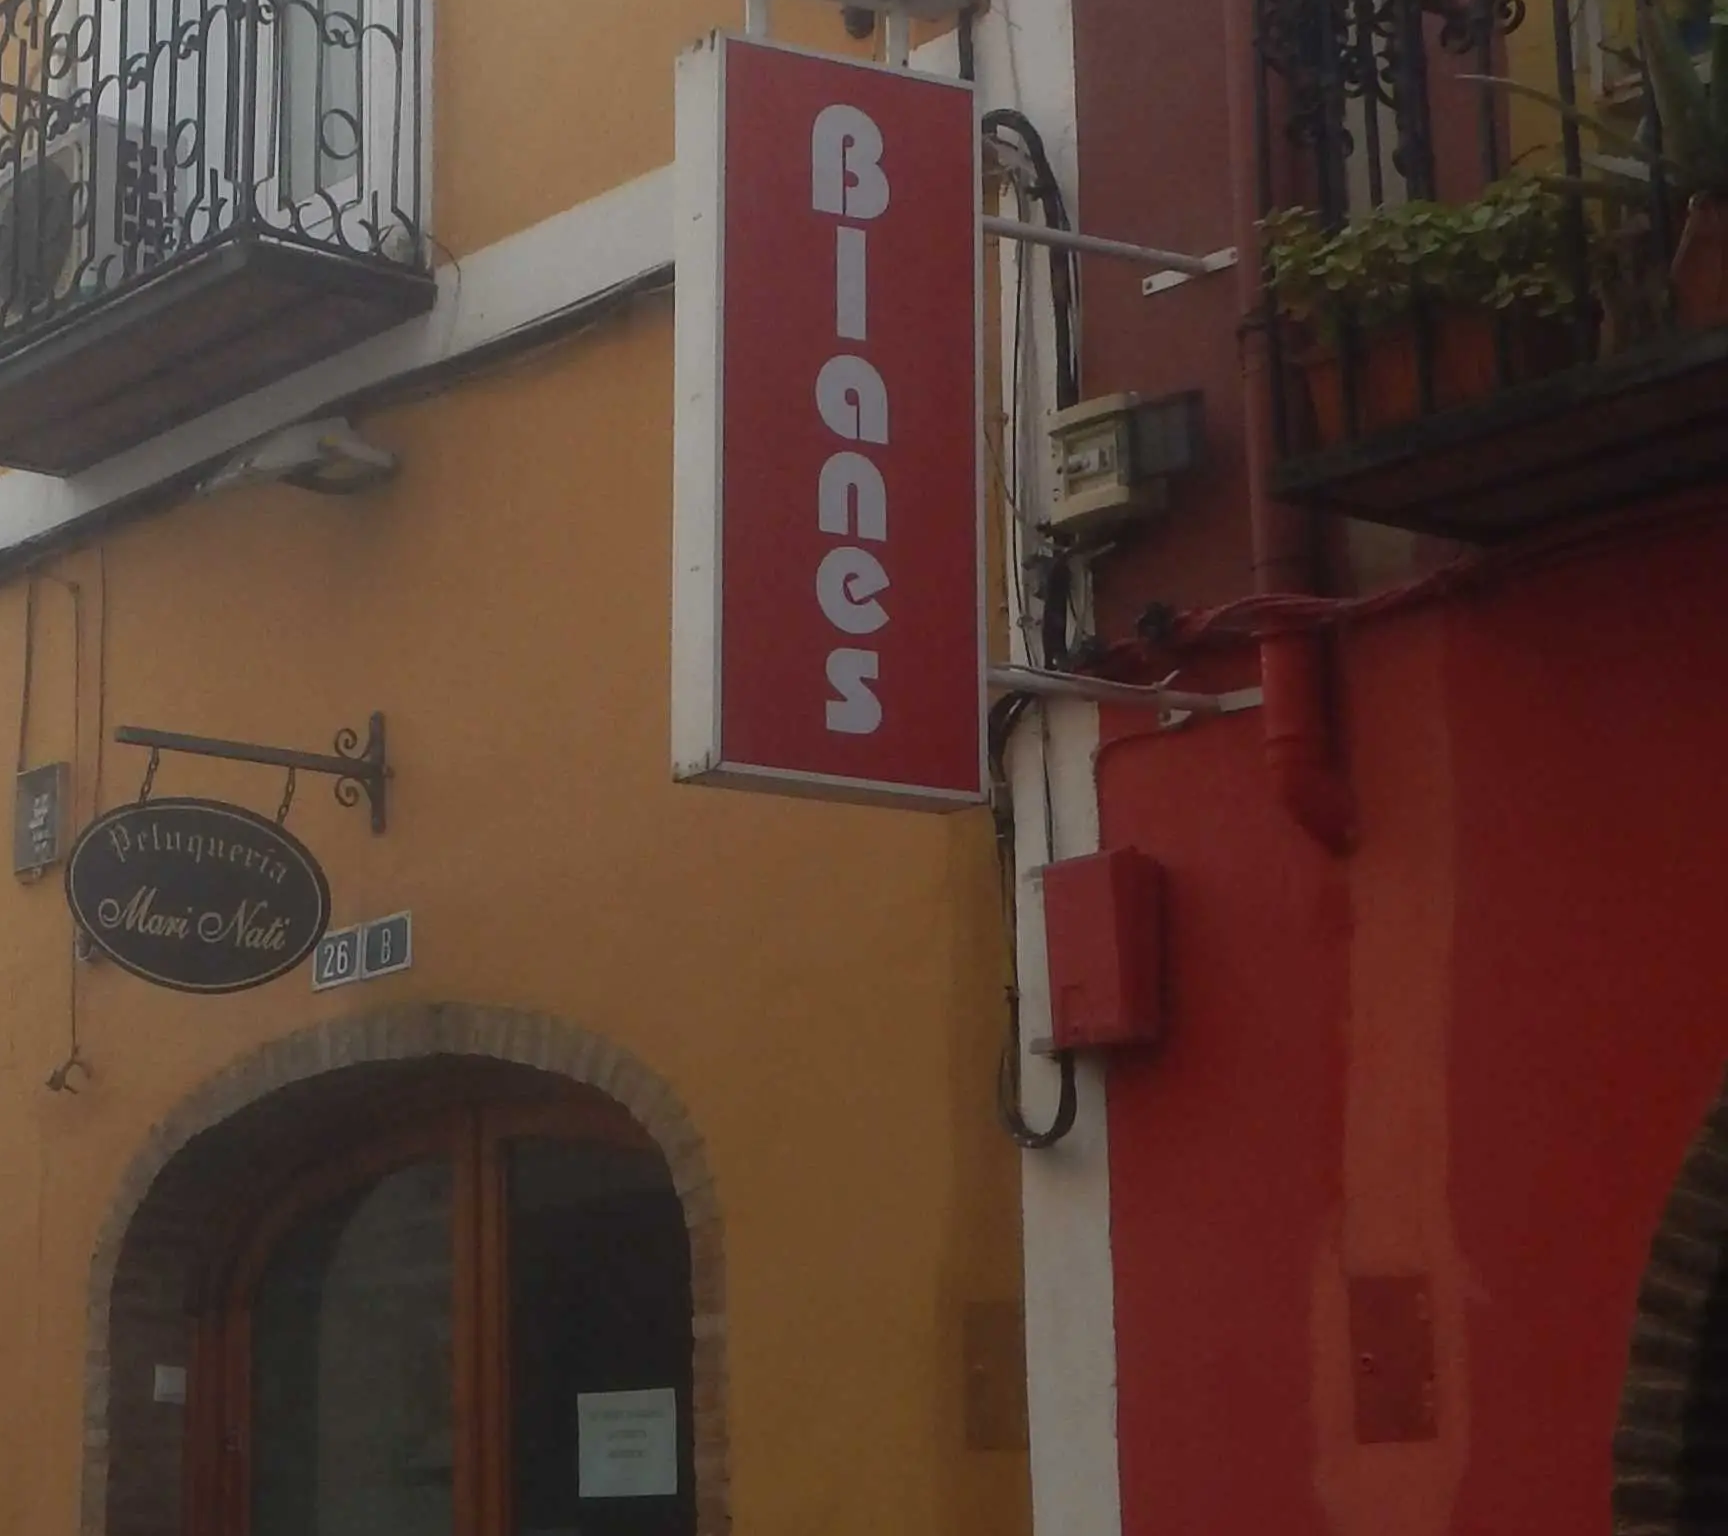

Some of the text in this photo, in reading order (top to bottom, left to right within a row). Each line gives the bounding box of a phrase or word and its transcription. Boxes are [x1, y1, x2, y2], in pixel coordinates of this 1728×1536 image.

[812, 103, 890, 735] Blanes
[98, 885, 292, 952] Mari Nati
[322, 927, 392, 978] 26 B
